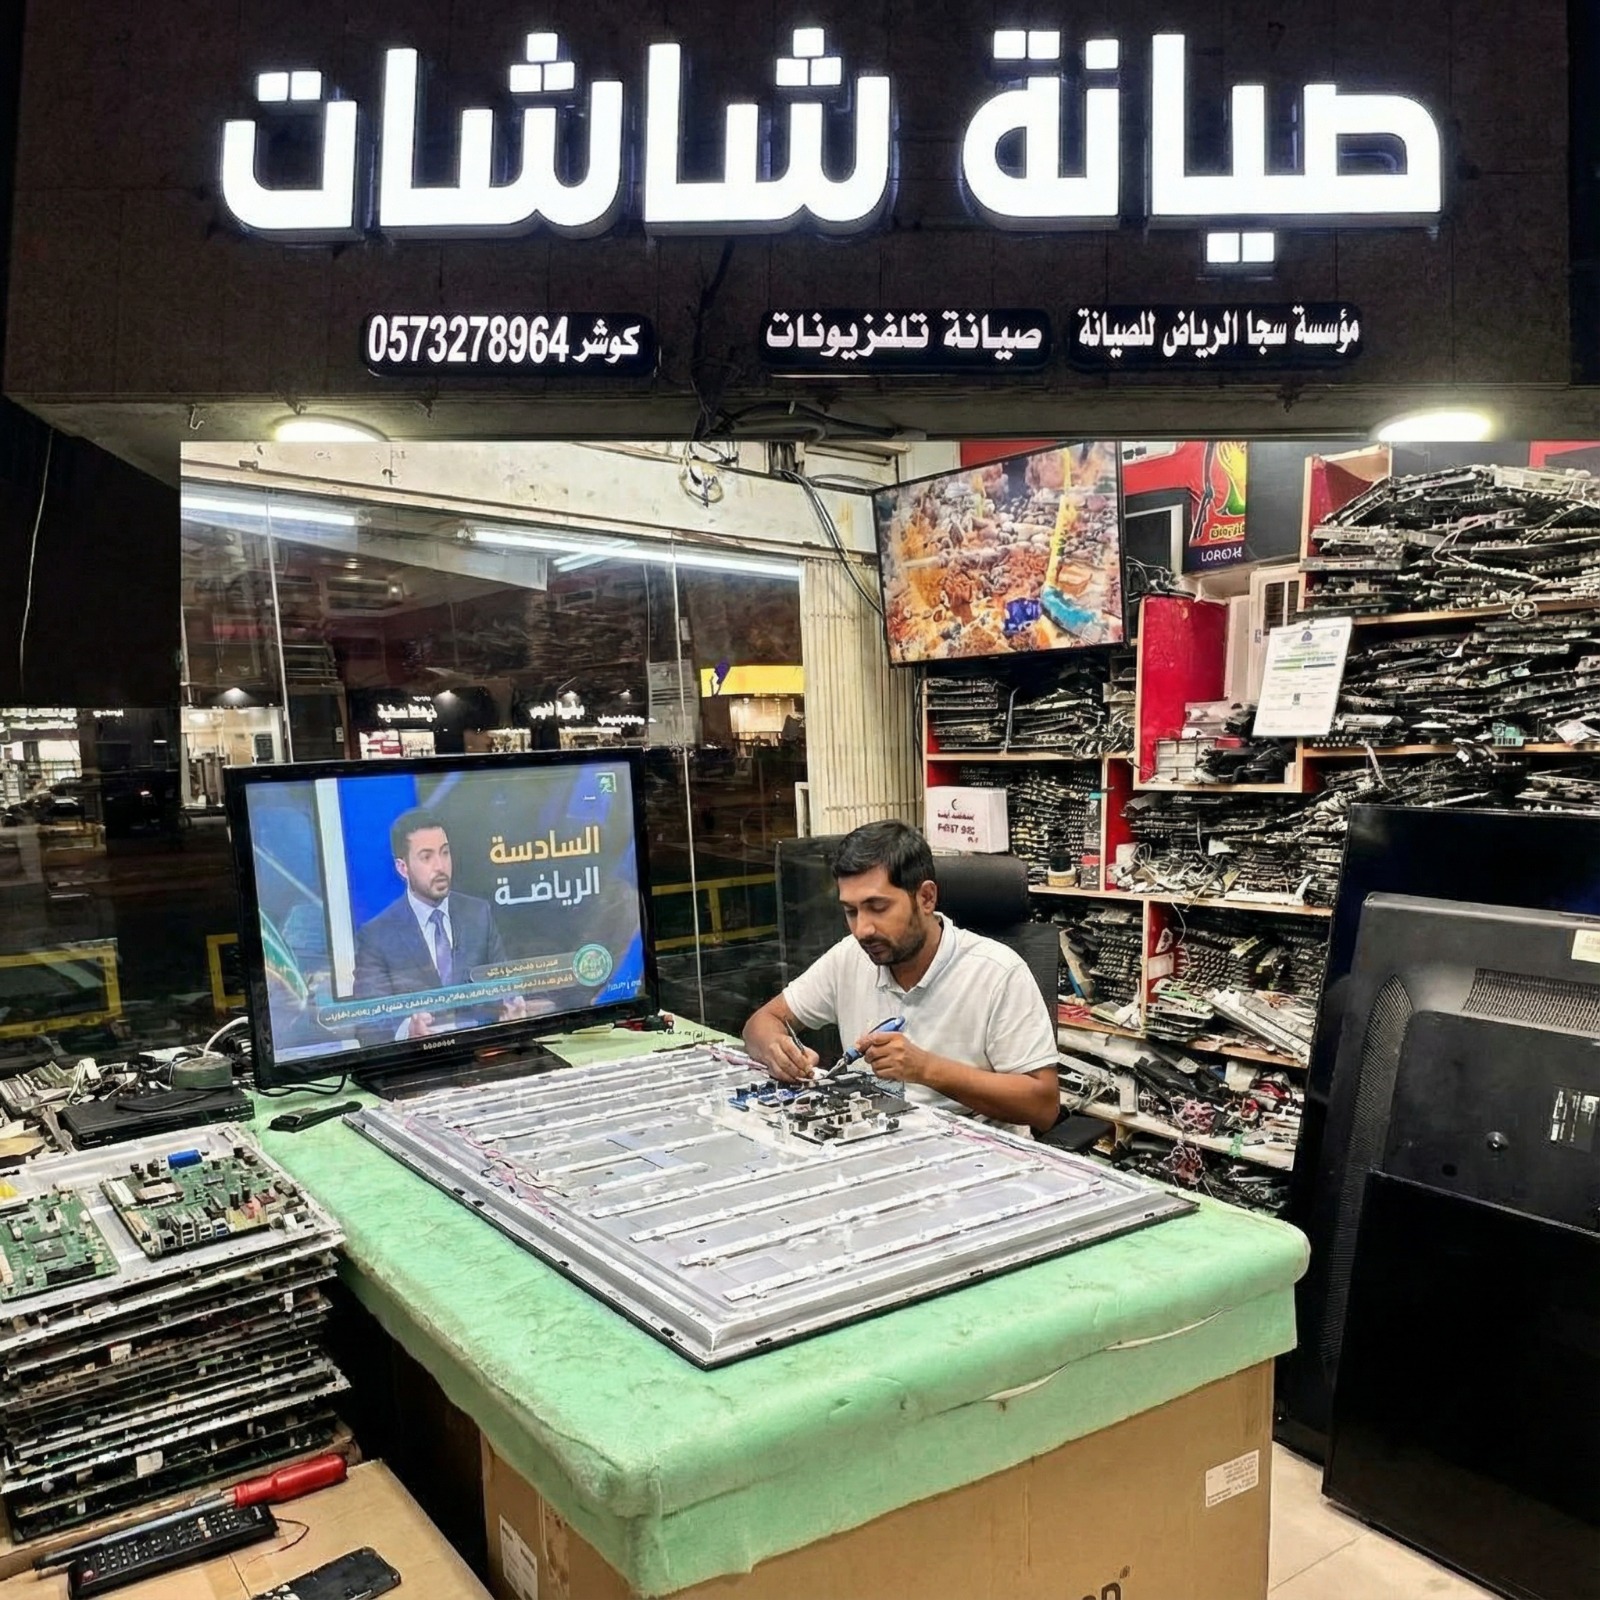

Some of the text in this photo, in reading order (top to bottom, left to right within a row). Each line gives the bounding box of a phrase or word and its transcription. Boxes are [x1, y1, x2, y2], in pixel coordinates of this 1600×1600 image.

[222, 27, 1441, 264] صيانة شاشات
[368, 314, 641, 364] كوشر 0573278964
[766, 310, 1043, 361] صيانة تلفزيونات
[1077, 305, 1360, 359] مؤسسة سجا الرياض للصيانة
[489, 825, 600, 864] السادسة
[494, 866, 600, 906] الرياضة
